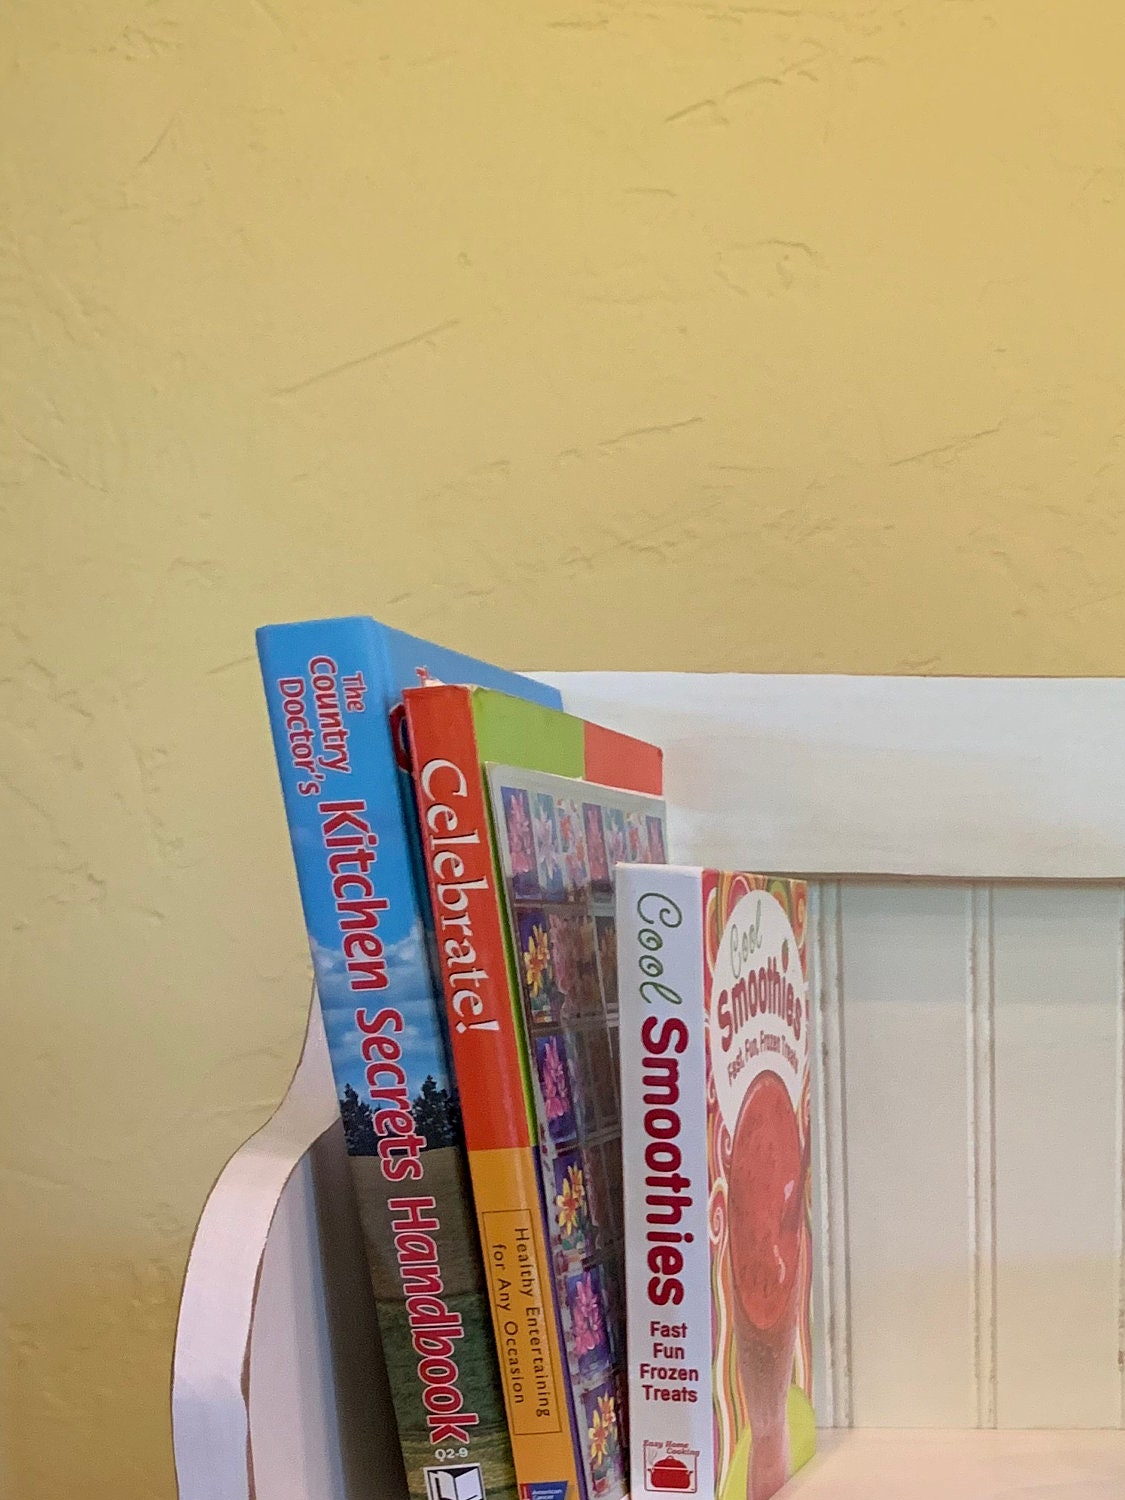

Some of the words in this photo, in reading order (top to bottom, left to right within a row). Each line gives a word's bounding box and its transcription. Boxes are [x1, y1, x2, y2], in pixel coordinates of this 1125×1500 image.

[277, 676, 326, 797] Doctor's
[308, 655, 351, 774] Country
[341, 670, 368, 713] The
[318, 799, 391, 992] Kitchen
[421, 758, 500, 1035] Celebrate!
[730, 899, 762, 980] Cool
[637, 892, 683, 1005] Cool
[717, 938, 802, 1053] Smoothies
[356, 1007, 428, 1181] Secrets
[640, 1015, 694, 1307] Smoothies
[492, 1243, 507, 1271] for
[496, 1278, 512, 1311] Any
[387, 1196, 480, 1444] Handbook
[504, 1321, 525, 1404] Occasion
[514, 1228, 536, 1297] Healthy
[525, 1307, 550, 1417] Entertaining
[650, 1320, 688, 1338] Fast
[653, 1343, 685, 1359] Fun
[640, 1363, 699, 1381] Frozen
[642, 1384, 698, 1403] Treats
[434, 1447, 468, 1462] Q2-9
